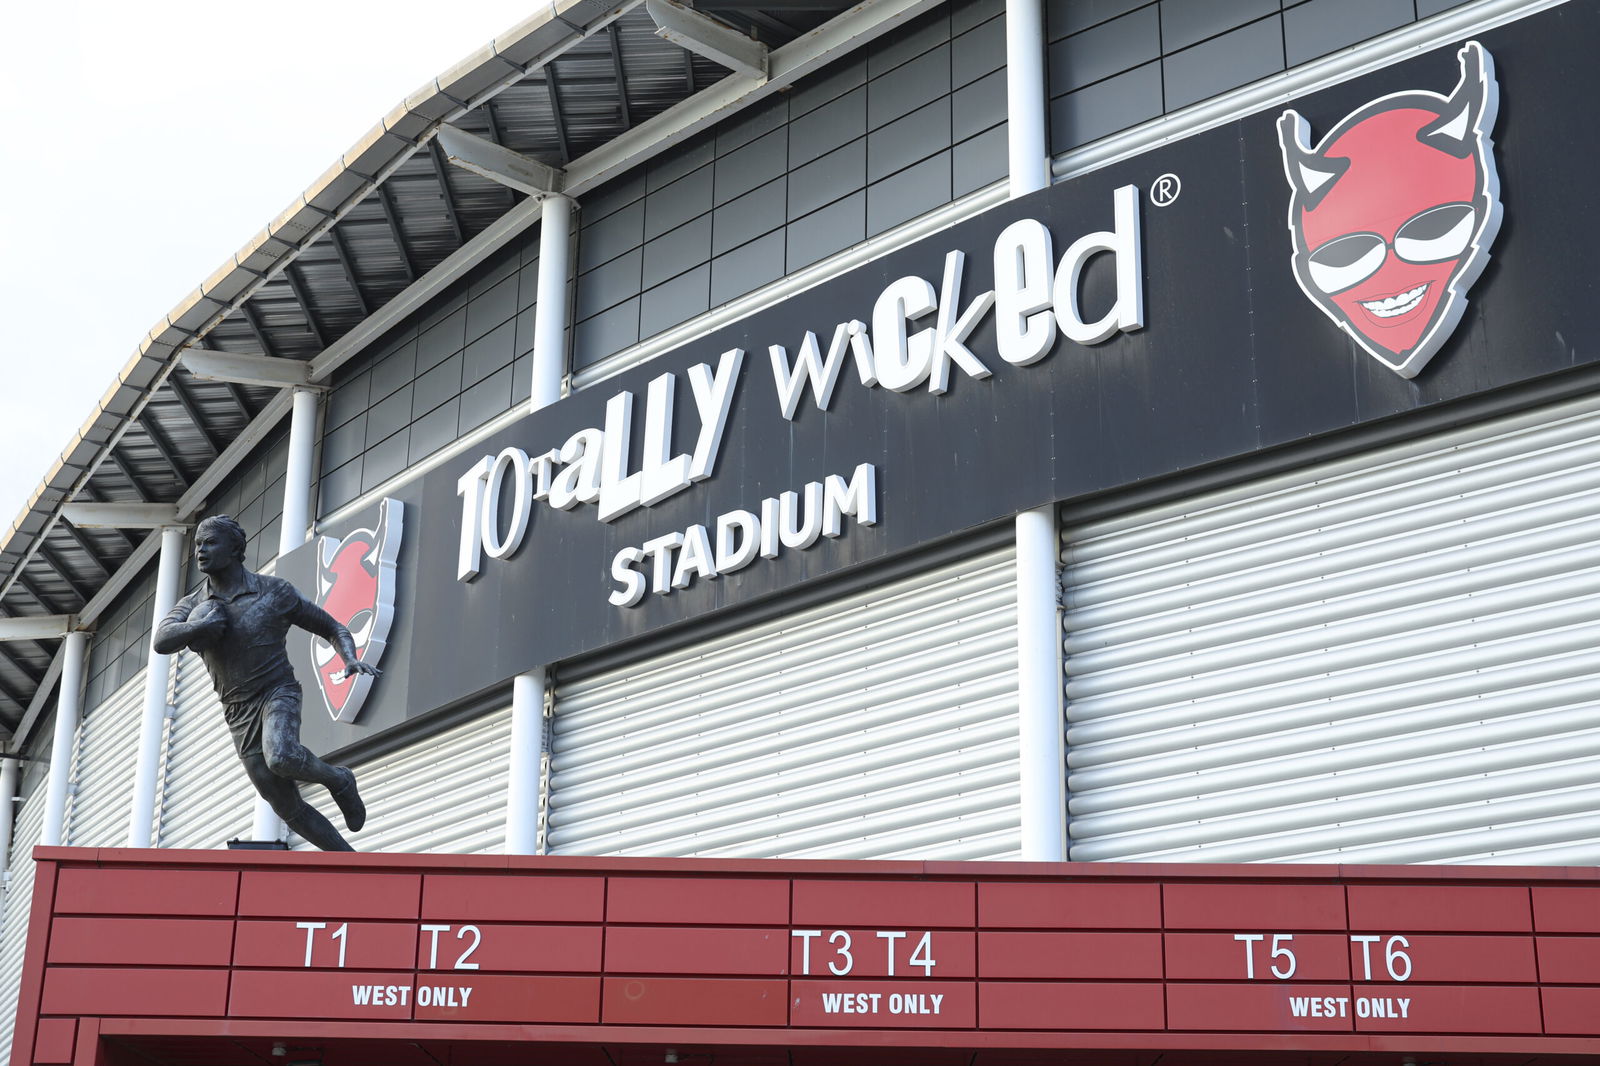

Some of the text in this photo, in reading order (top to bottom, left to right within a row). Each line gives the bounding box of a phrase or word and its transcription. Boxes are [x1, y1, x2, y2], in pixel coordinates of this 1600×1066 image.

[608, 462, 877, 607] STADIUM
[296, 921, 481, 970] T1 T2
[791, 929, 936, 977] T3 T4
[1233, 933, 1412, 982] T5 T6
[352, 984, 473, 1008] WEST ONLY
[822, 992, 944, 1015] WEST ONLY
[1289, 996, 1411, 1019] WEST ONLY
